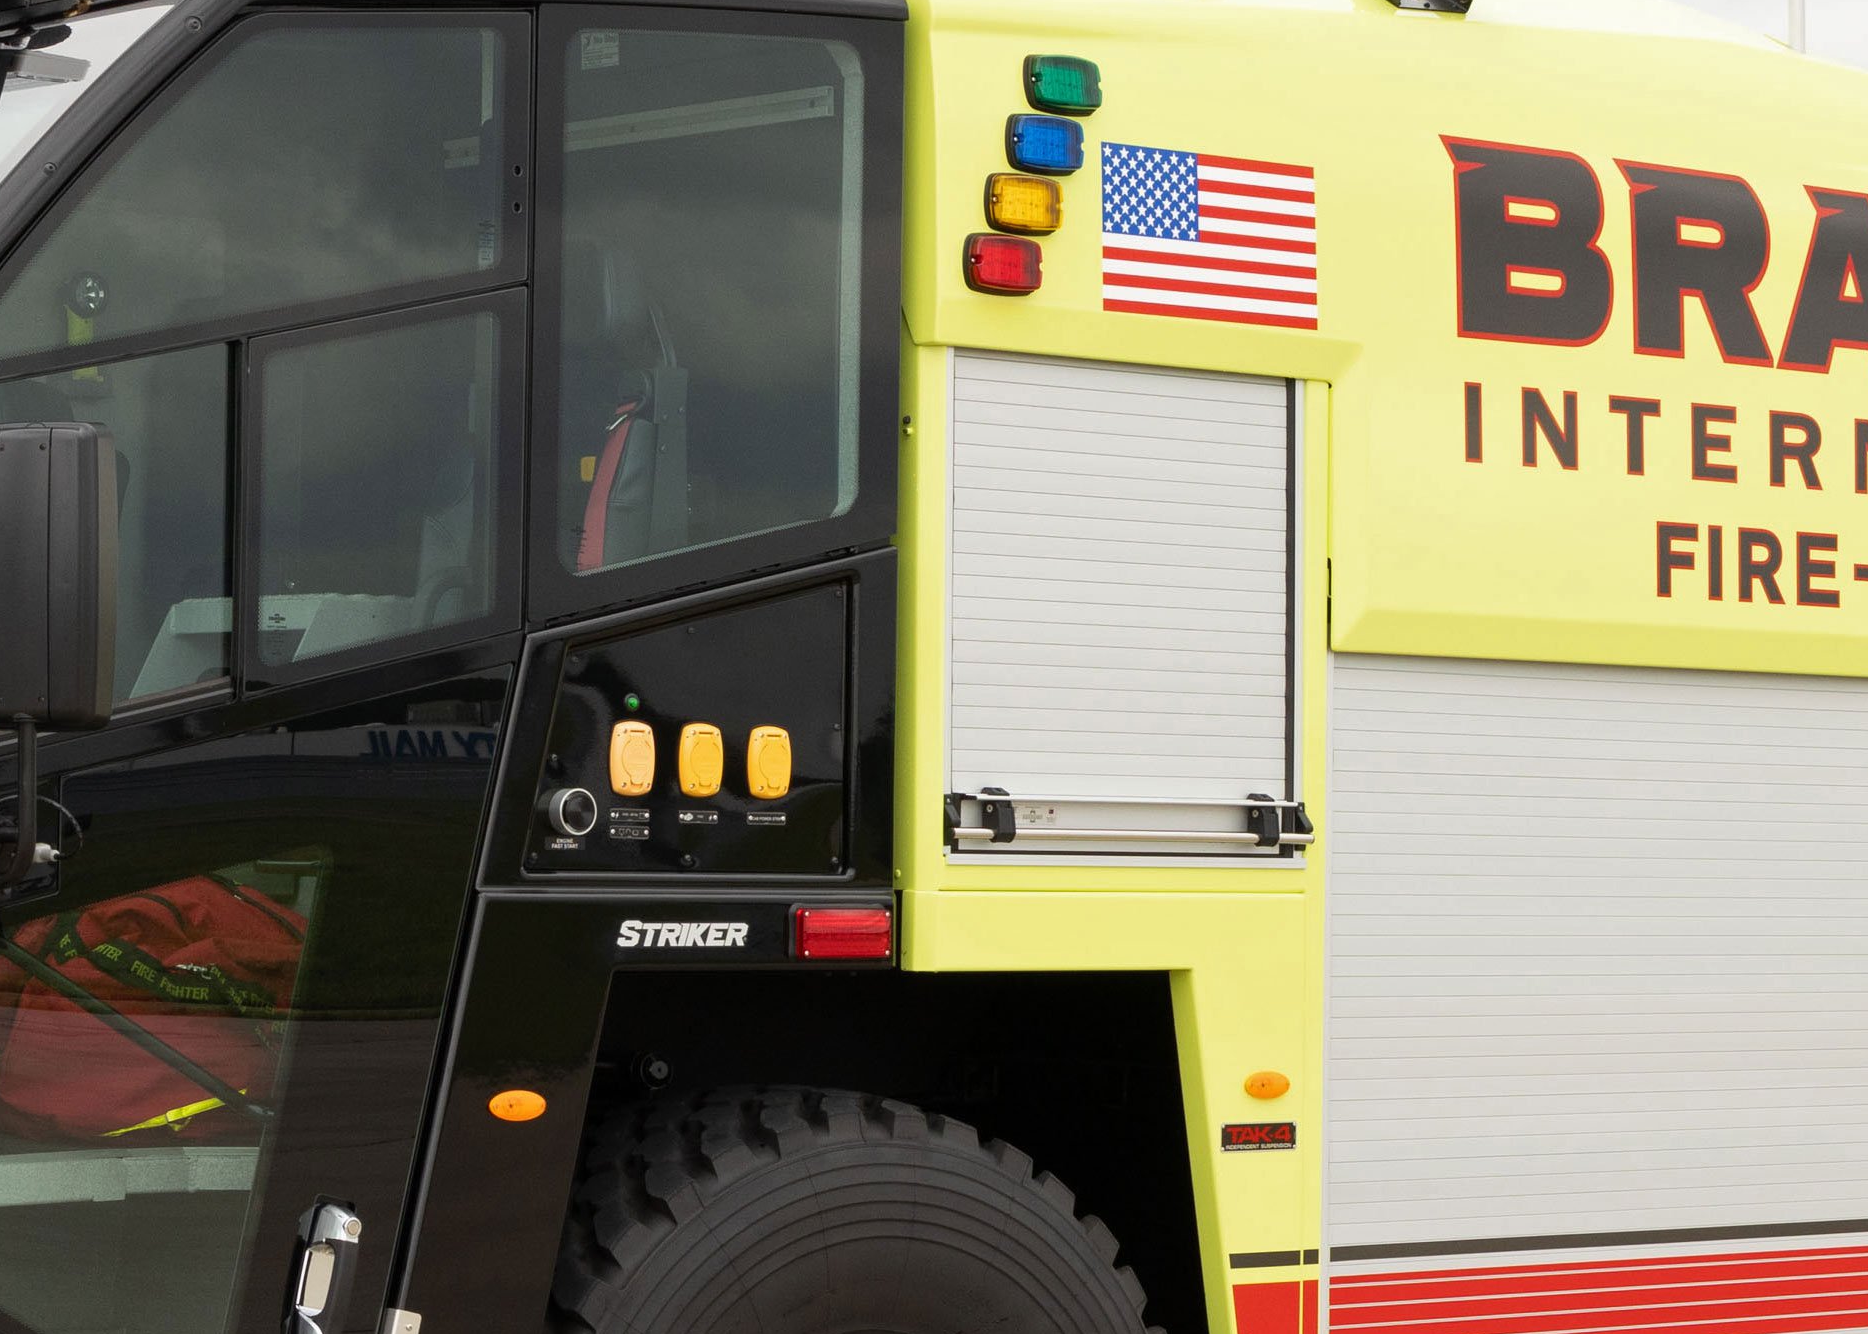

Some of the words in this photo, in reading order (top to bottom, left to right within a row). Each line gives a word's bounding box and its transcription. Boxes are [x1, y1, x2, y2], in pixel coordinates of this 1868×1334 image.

[616, 920, 748, 947] STRIKER
[130, 959, 157, 983] FIRE
[159, 977, 209, 1000] FIGHTER
